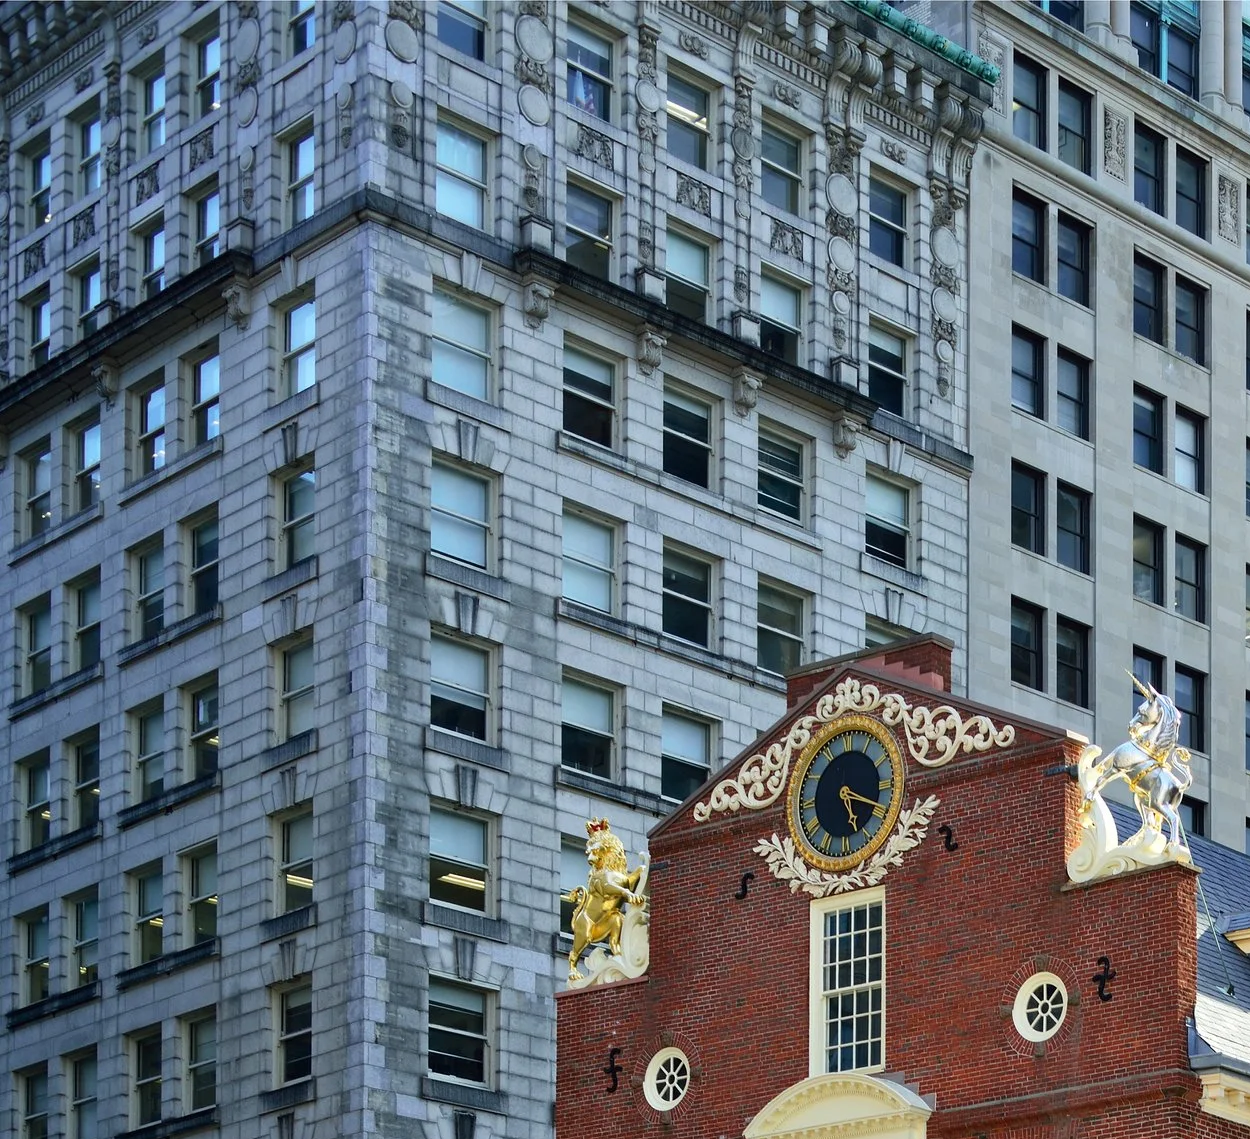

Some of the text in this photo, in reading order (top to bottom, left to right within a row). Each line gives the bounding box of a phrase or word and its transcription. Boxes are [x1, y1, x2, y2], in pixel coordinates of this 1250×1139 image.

[862, 736, 870, 753] I
[874, 754, 886, 767] II
[879, 780, 891, 790] III
